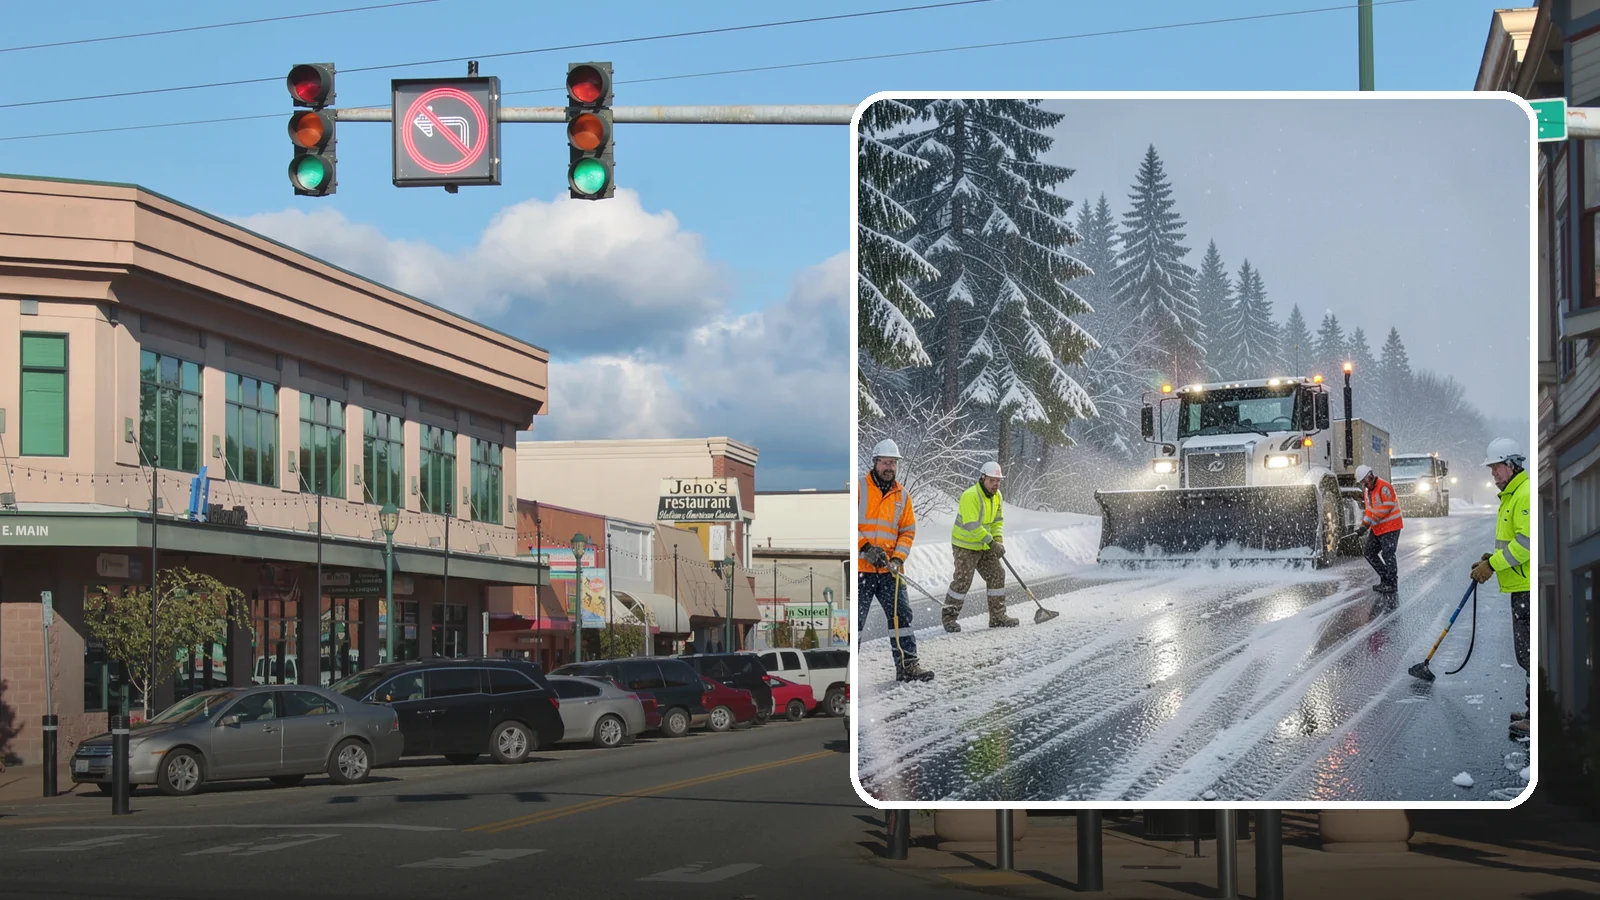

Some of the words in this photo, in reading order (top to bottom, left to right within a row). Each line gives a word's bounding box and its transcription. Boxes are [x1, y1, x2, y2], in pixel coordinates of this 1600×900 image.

[669, 480, 727, 495] Jeno's
[665, 496, 731, 509] restaurant
[659, 509, 682, 519] Italian
[686, 509, 714, 519] American
[715, 509, 737, 519] Cuisine
[2, 525, 13, 536] E.
[15, 525, 49, 536] MAIN
[797, 607, 828, 617] Street
[791, 619, 824, 627] lass
